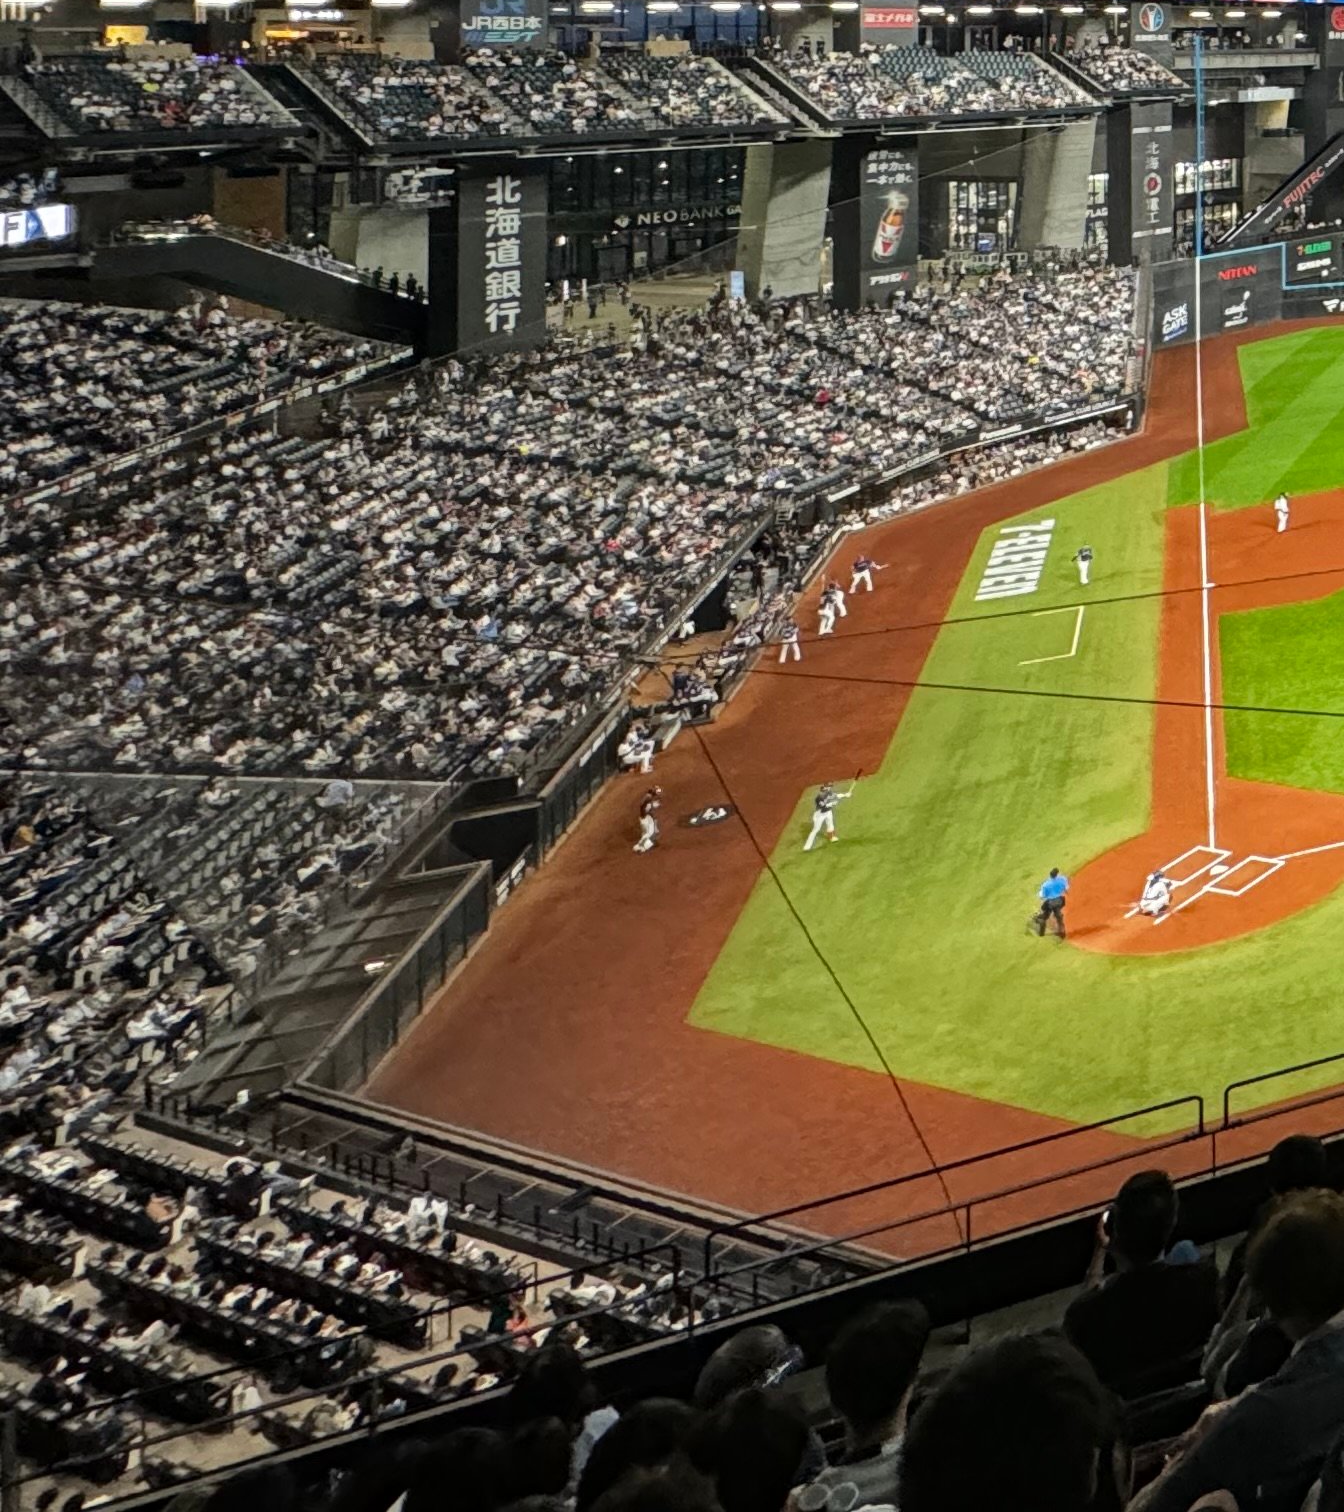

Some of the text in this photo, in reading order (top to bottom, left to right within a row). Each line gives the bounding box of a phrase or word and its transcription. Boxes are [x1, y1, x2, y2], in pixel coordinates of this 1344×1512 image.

[461, 16, 543, 31] JR西日本
[485, 175, 522, 333] 北海道銀行
[1163, 303, 1188, 325] ASK
[1162, 316, 1188, 335] GATE
